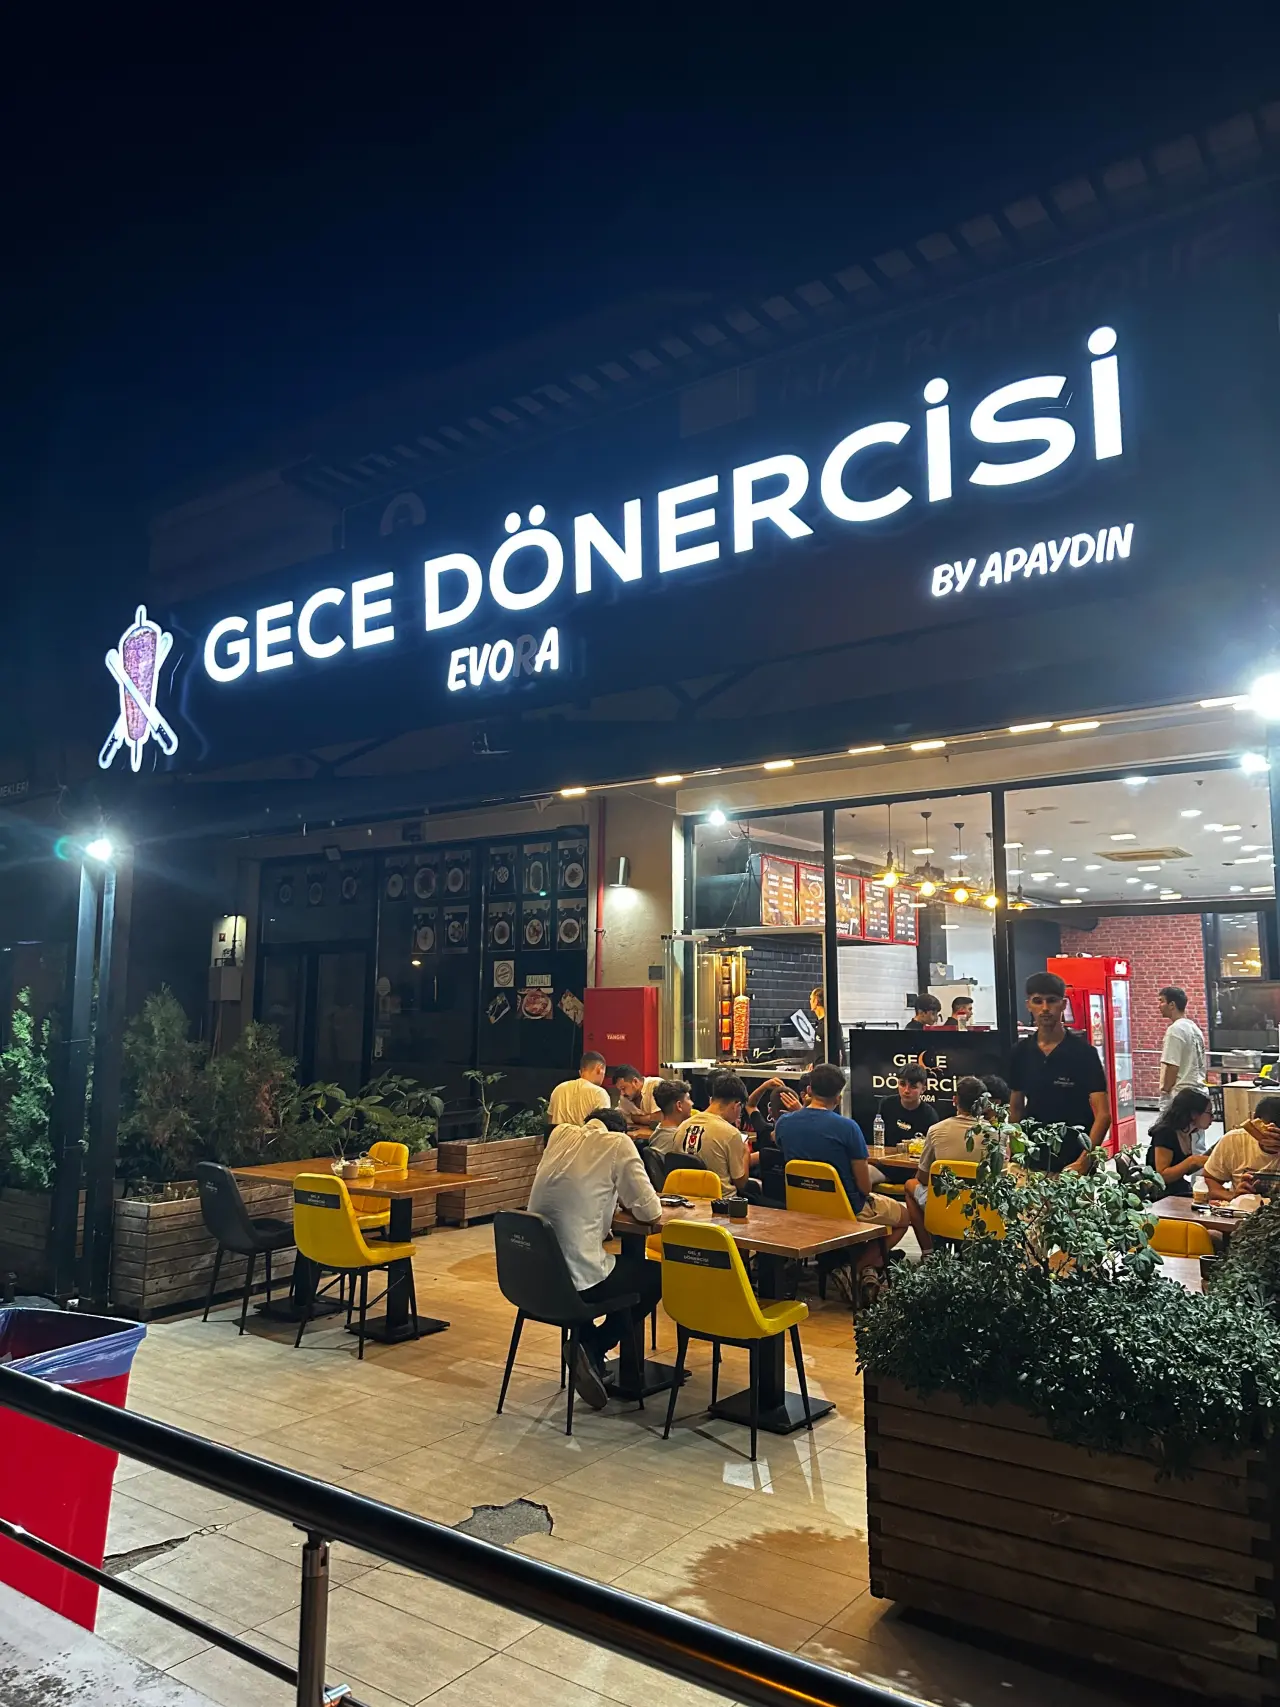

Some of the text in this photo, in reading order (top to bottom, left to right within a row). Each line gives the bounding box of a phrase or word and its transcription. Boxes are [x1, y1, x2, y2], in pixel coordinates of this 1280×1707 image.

[204, 326, 1123, 682] GECE DÖNERCİSİ
[931, 523, 1134, 597] BY APAYDIN
[448, 626, 559, 691] EVORA
